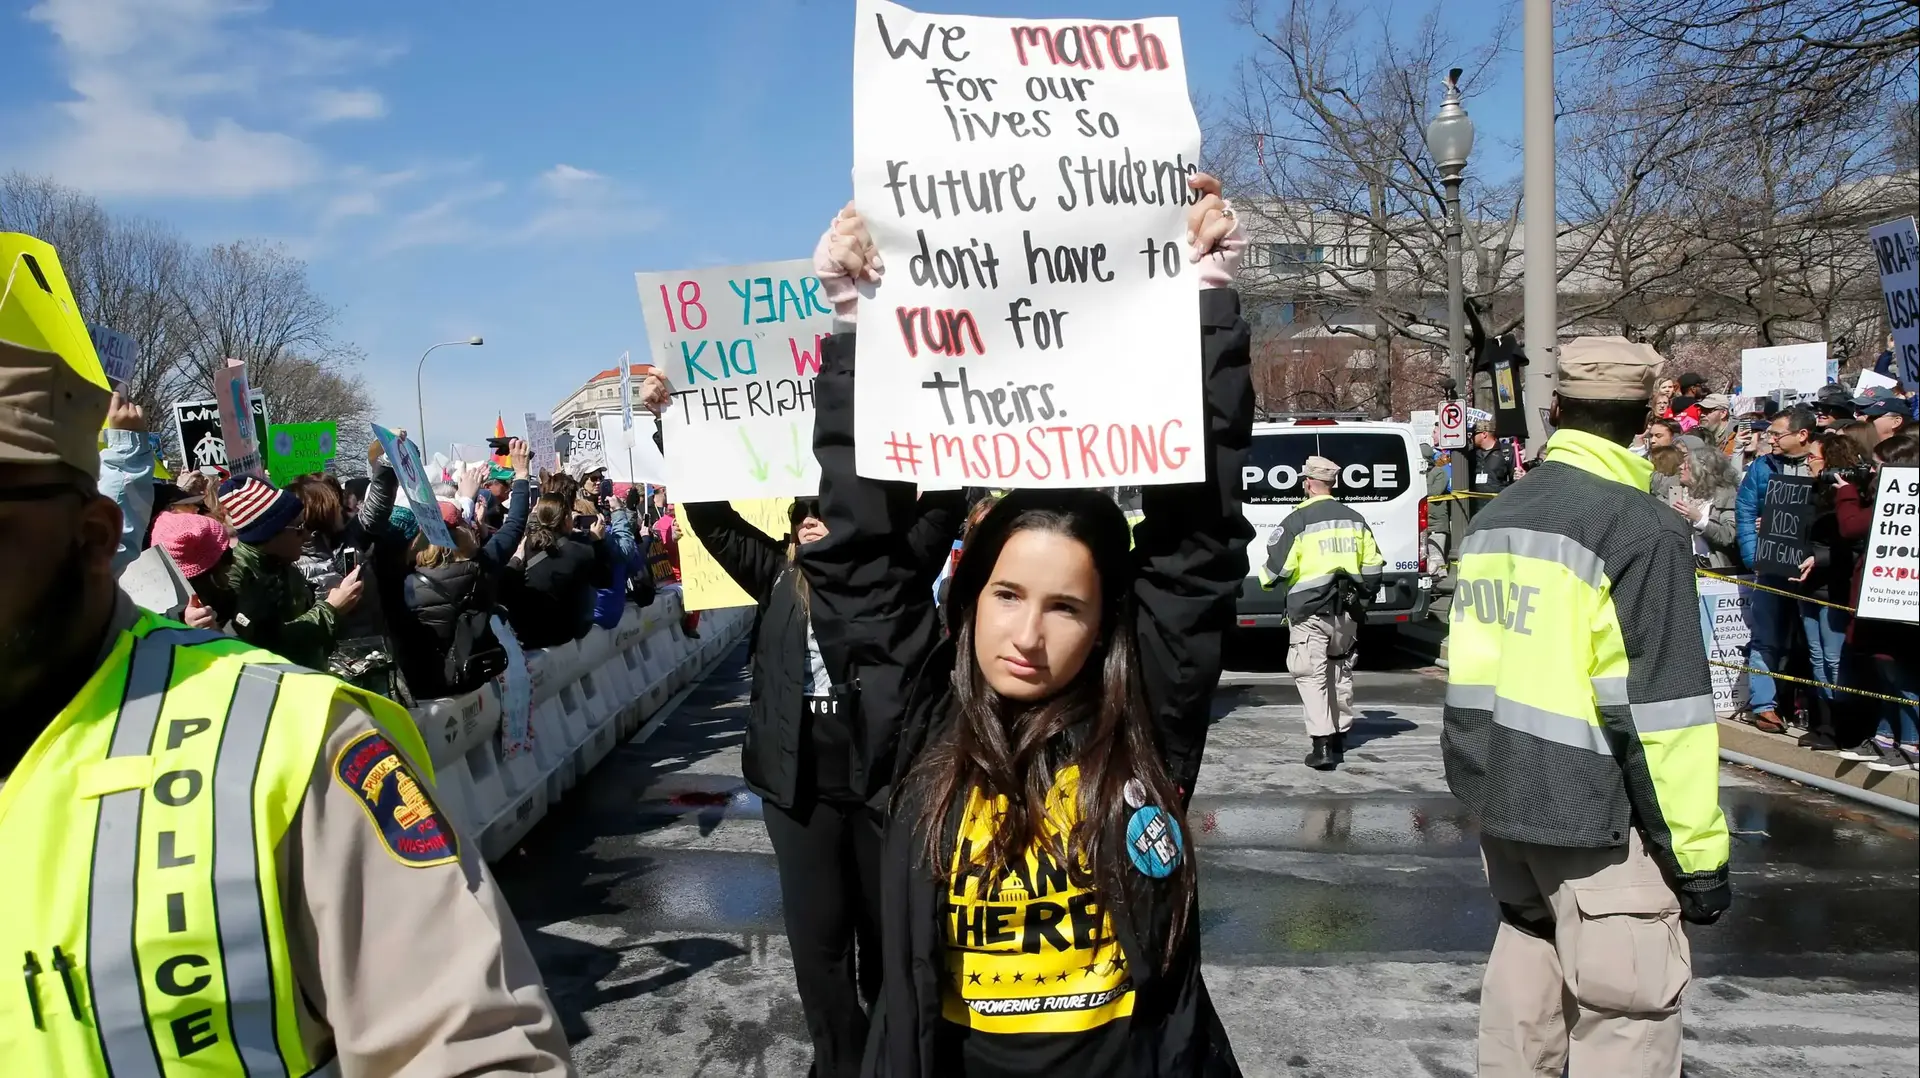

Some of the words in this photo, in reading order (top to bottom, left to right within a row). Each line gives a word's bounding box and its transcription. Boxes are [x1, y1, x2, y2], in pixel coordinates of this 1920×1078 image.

[876, 13, 970, 62] We
[1010, 22, 1170, 72] march
[926, 68, 998, 102] for
[1026, 76, 1095, 102] our
[944, 104, 1052, 142] lives
[1076, 108, 1120, 138] so
[884, 160, 1036, 220] future
[909, 229, 1000, 289] don't
[1022, 230, 1114, 284] have
[1139, 236, 1181, 279] to
[1872, 232, 1911, 276] NRA
[660, 281, 708, 332] 18
[895, 306, 986, 358] run
[1004, 298, 1070, 350] for
[670, 387, 740, 425] THE
[884, 419, 1191, 480] #MSDSTRONG
[1764, 480, 1812, 504] PROTECT
[1886, 478, 1900, 493] A
[1770, 509, 1800, 535] KIDS
[1882, 502, 1919, 517] gra
[1880, 520, 1912, 536] the
[1395, 560, 1418, 570] 9669
[1756, 538, 1776, 562] NOT
[1776, 542, 1804, 568] GUNS
[1878, 596, 1900, 606] bring
[1886, 587, 1906, 596] have
[1716, 614, 1743, 624] BAN
[1714, 690, 1739, 700] OVE
[1146, 816, 1166, 840] CALL
[153, 718, 219, 1058] POLICE
[1043, 994, 1086, 1010] FUTURE
